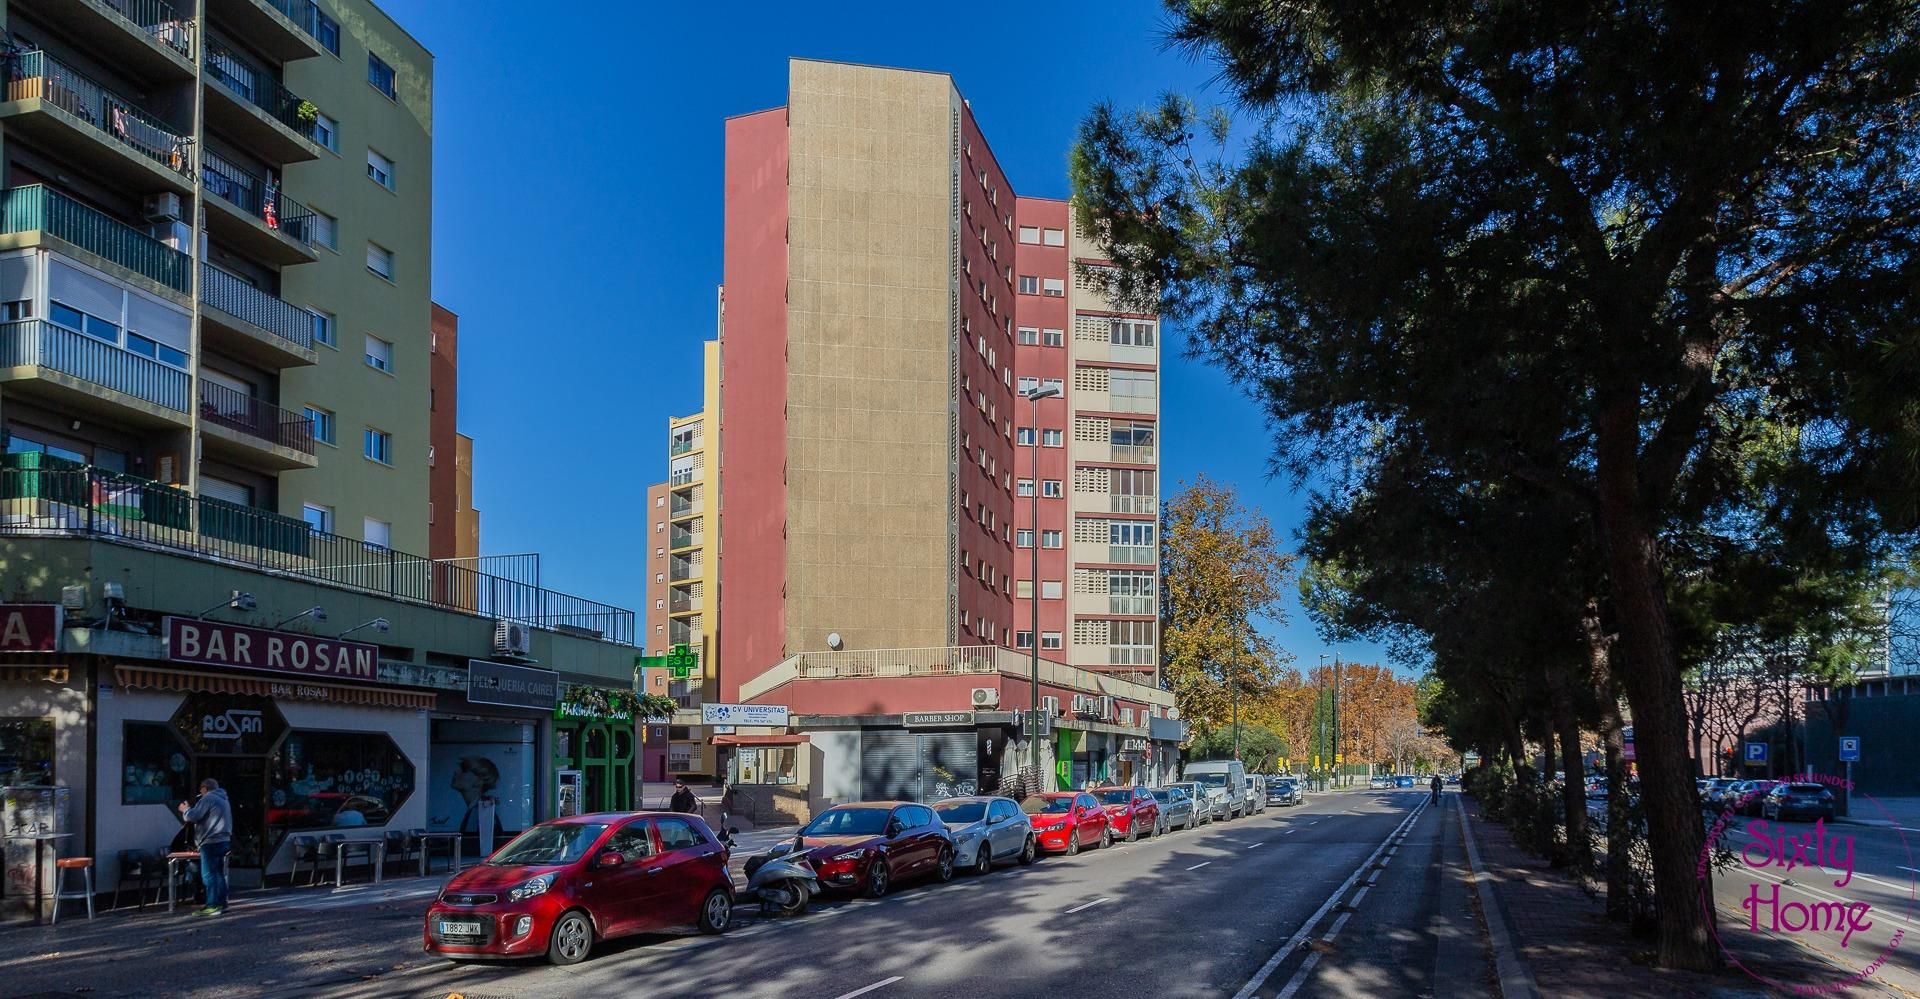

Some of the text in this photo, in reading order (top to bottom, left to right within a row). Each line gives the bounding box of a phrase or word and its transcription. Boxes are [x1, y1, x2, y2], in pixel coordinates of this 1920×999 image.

[180, 624, 252, 664] BAR
[267, 637, 371, 676] ROSAN
[271, 684, 328, 697] BAR ROSAN
[743, 706, 786, 714] UNIVERSITAS
[202, 709, 263, 740] ROSAN
[914, 714, 965, 723] BARBER SHOP
[1749, 745, 1763, 759] P
[445, 923, 463, 933] 1882
